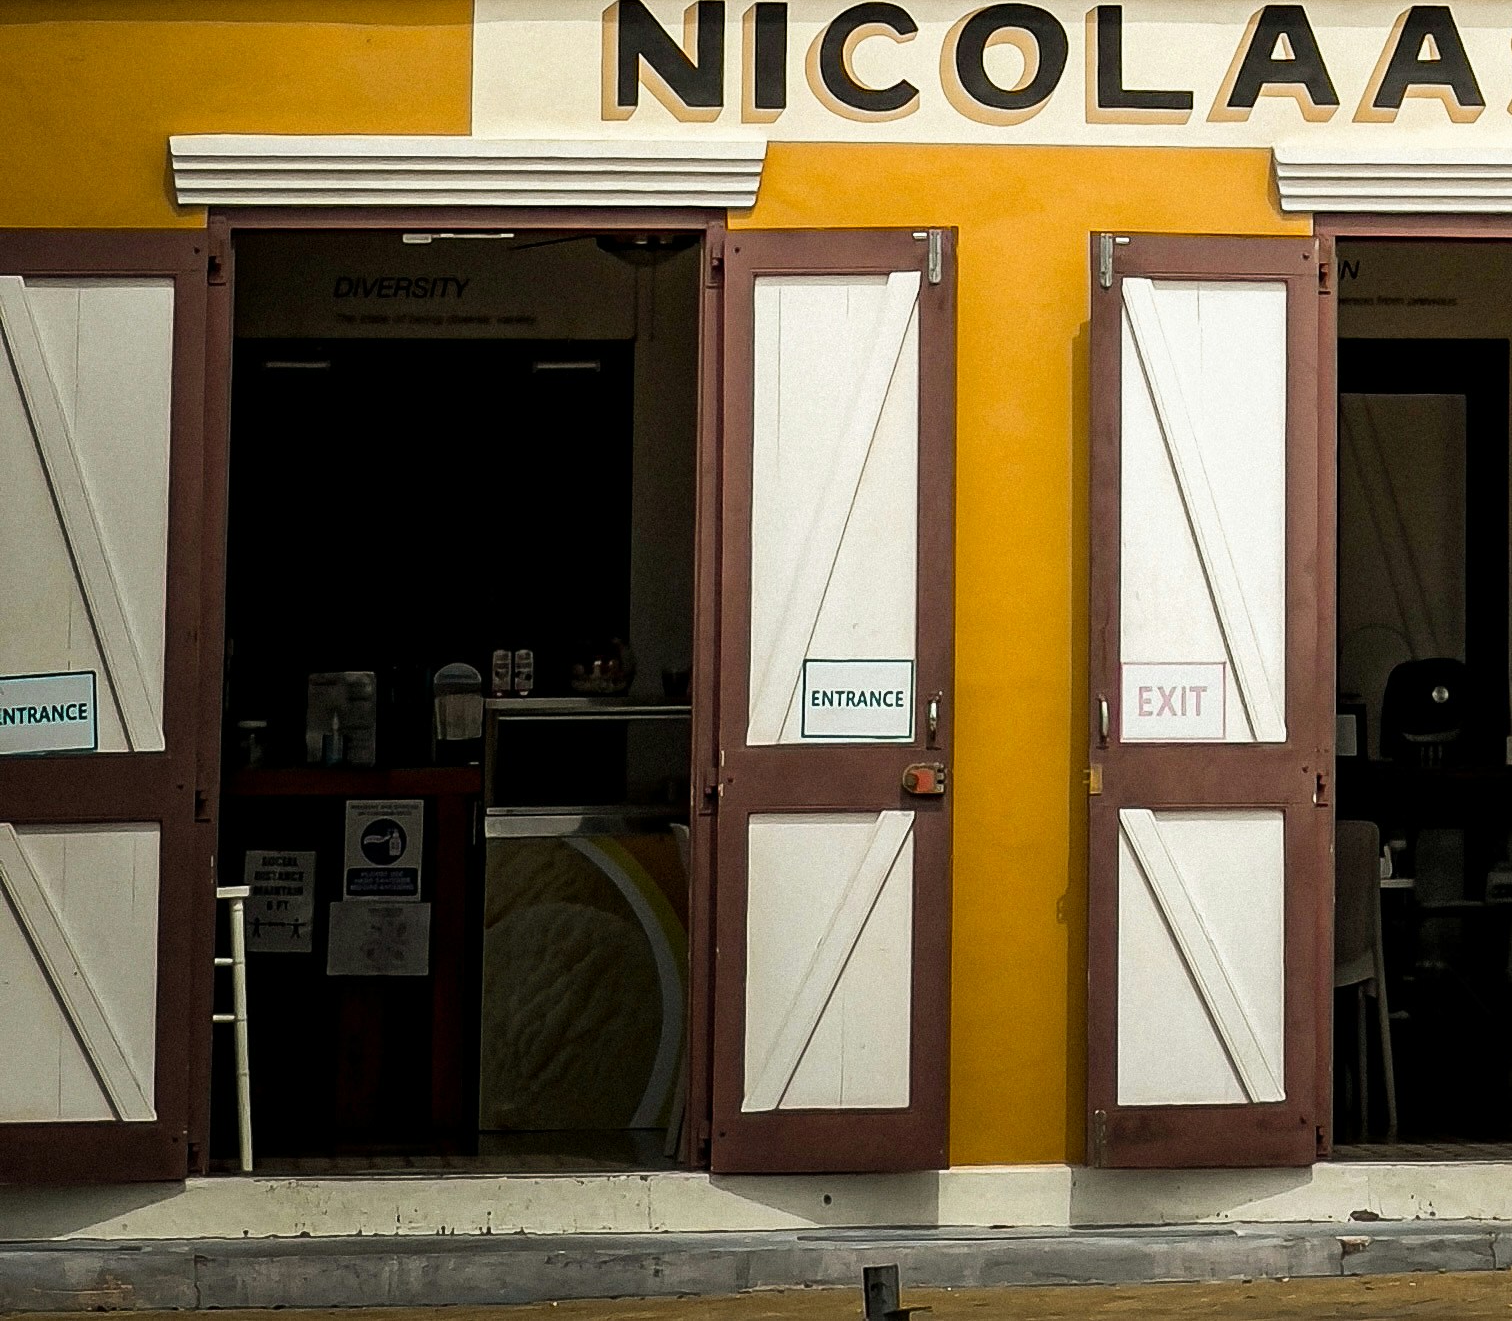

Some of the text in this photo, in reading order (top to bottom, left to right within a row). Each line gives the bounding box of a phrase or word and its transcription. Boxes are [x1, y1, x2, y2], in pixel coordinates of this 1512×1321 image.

[333, 276, 470, 299] DIVERSITY
[811, 690, 905, 708] ENTRANCE
[1138, 686, 1208, 717] EXIT
[0, 703, 88, 726] NTRANCE
